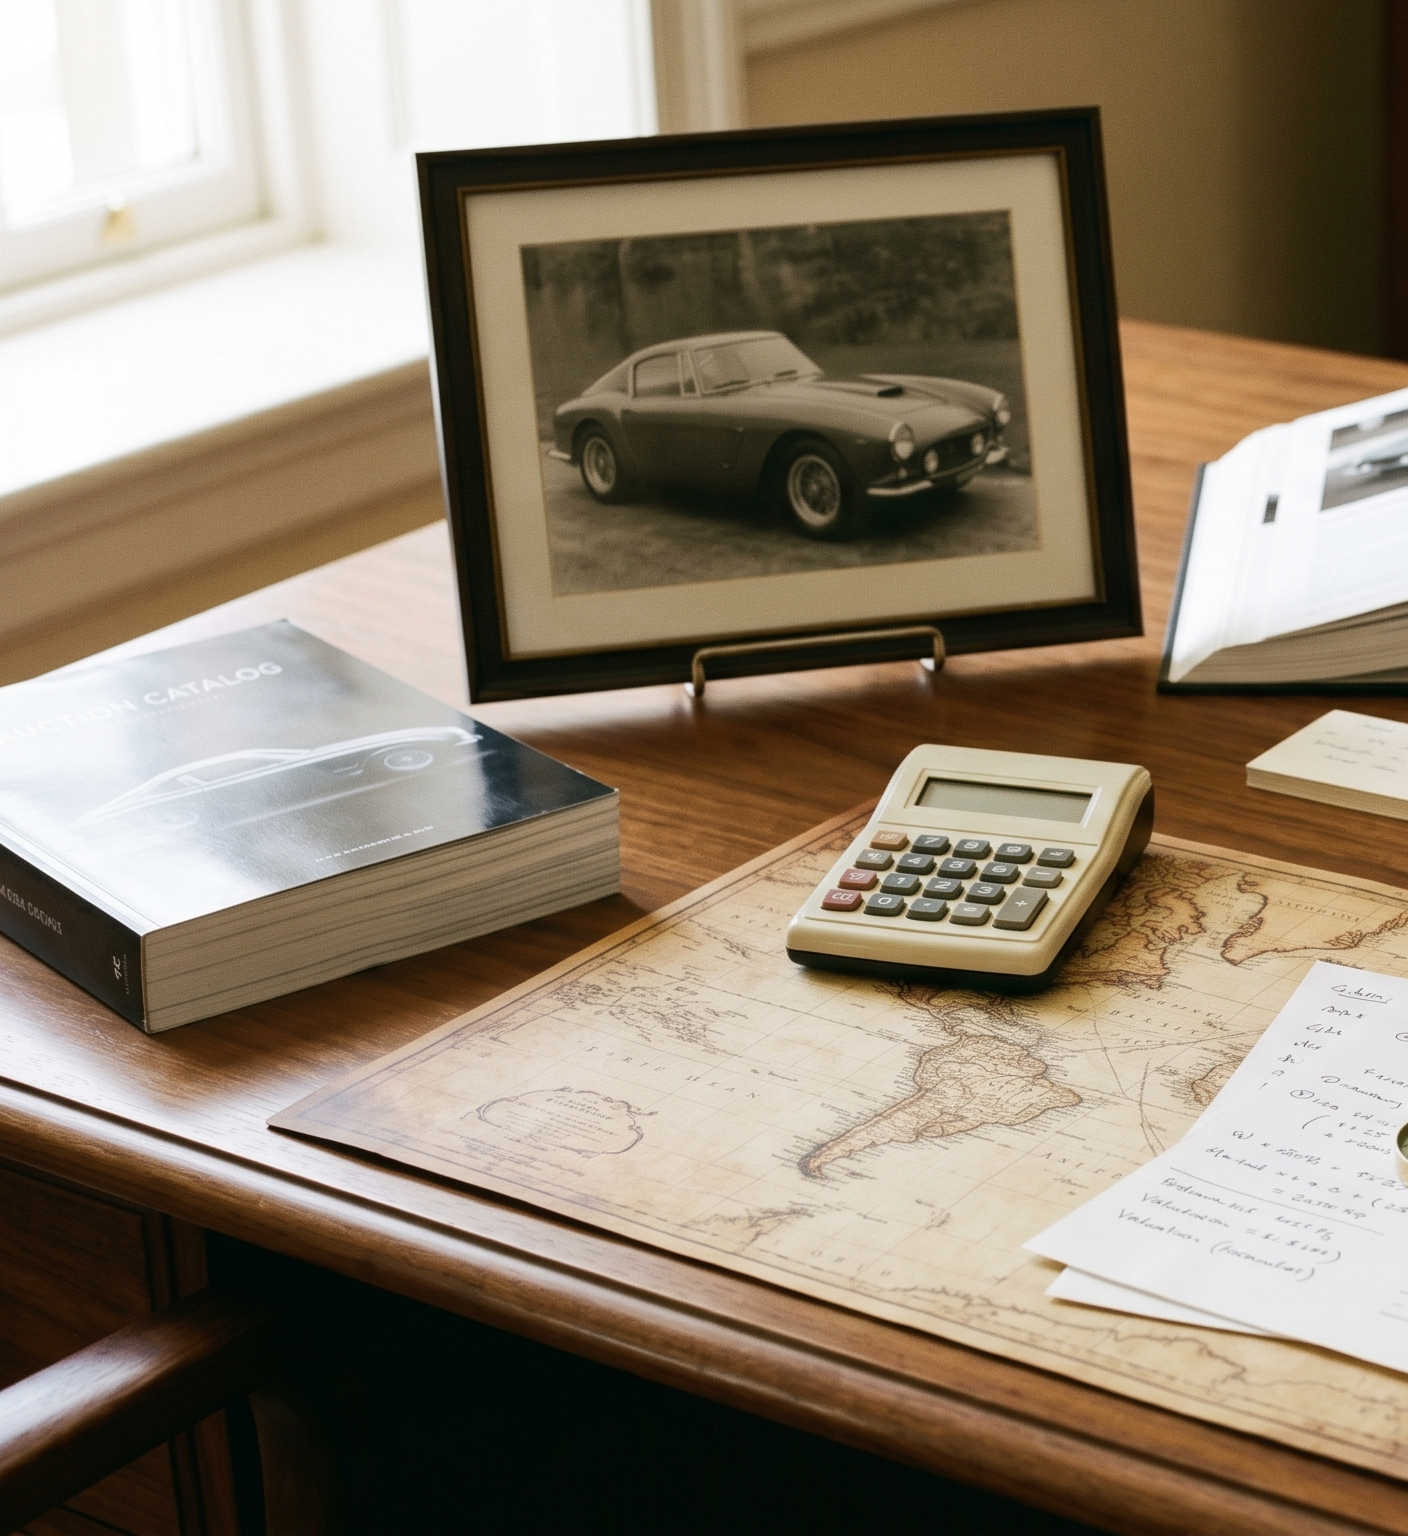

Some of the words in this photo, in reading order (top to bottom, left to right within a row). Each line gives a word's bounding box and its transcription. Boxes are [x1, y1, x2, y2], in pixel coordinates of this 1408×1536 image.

[143, 661, 283, 705] CATALOG
[924, 836, 940, 844] 7
[934, 881, 952, 889] 2
[977, 885, 993, 894] 3
